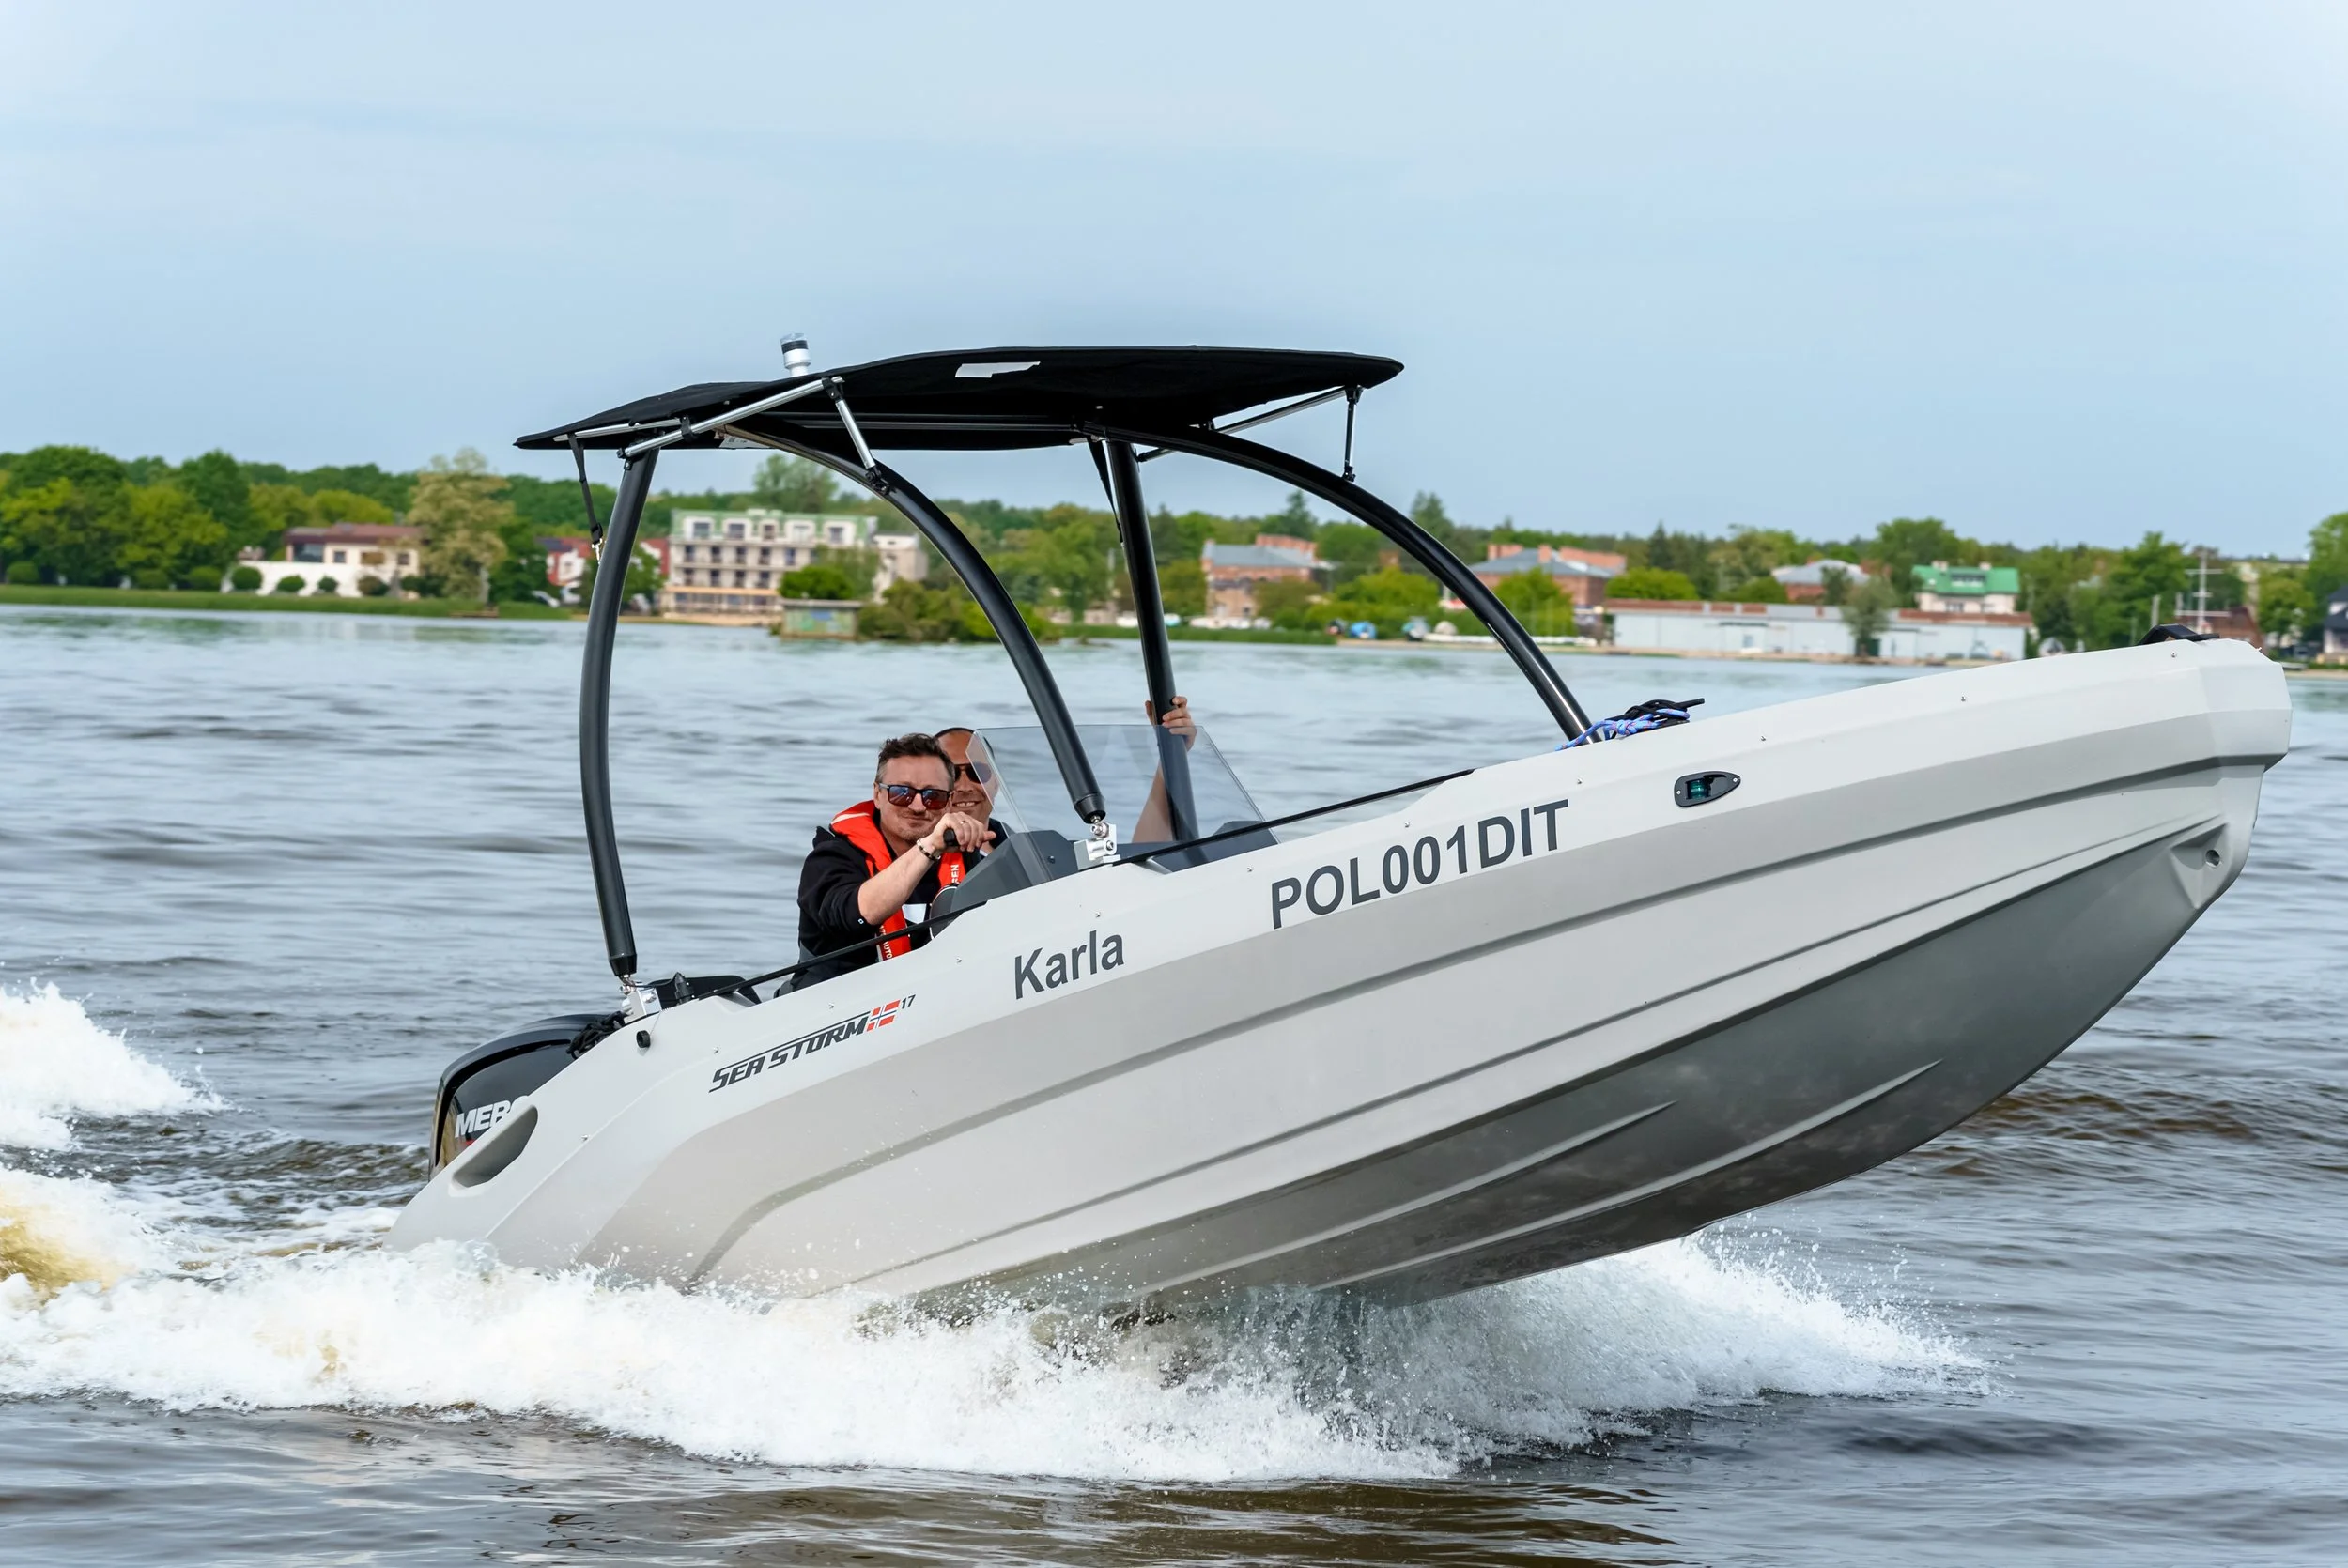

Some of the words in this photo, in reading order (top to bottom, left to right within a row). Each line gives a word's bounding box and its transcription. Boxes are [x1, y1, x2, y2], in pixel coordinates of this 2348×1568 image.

[1271, 798, 1569, 930] POL001DIT
[1014, 930, 1124, 1000] Karla
[709, 1053, 766, 1093] SEA
[768, 1014, 869, 1069] STORM
[901, 994, 916, 1010] 17
